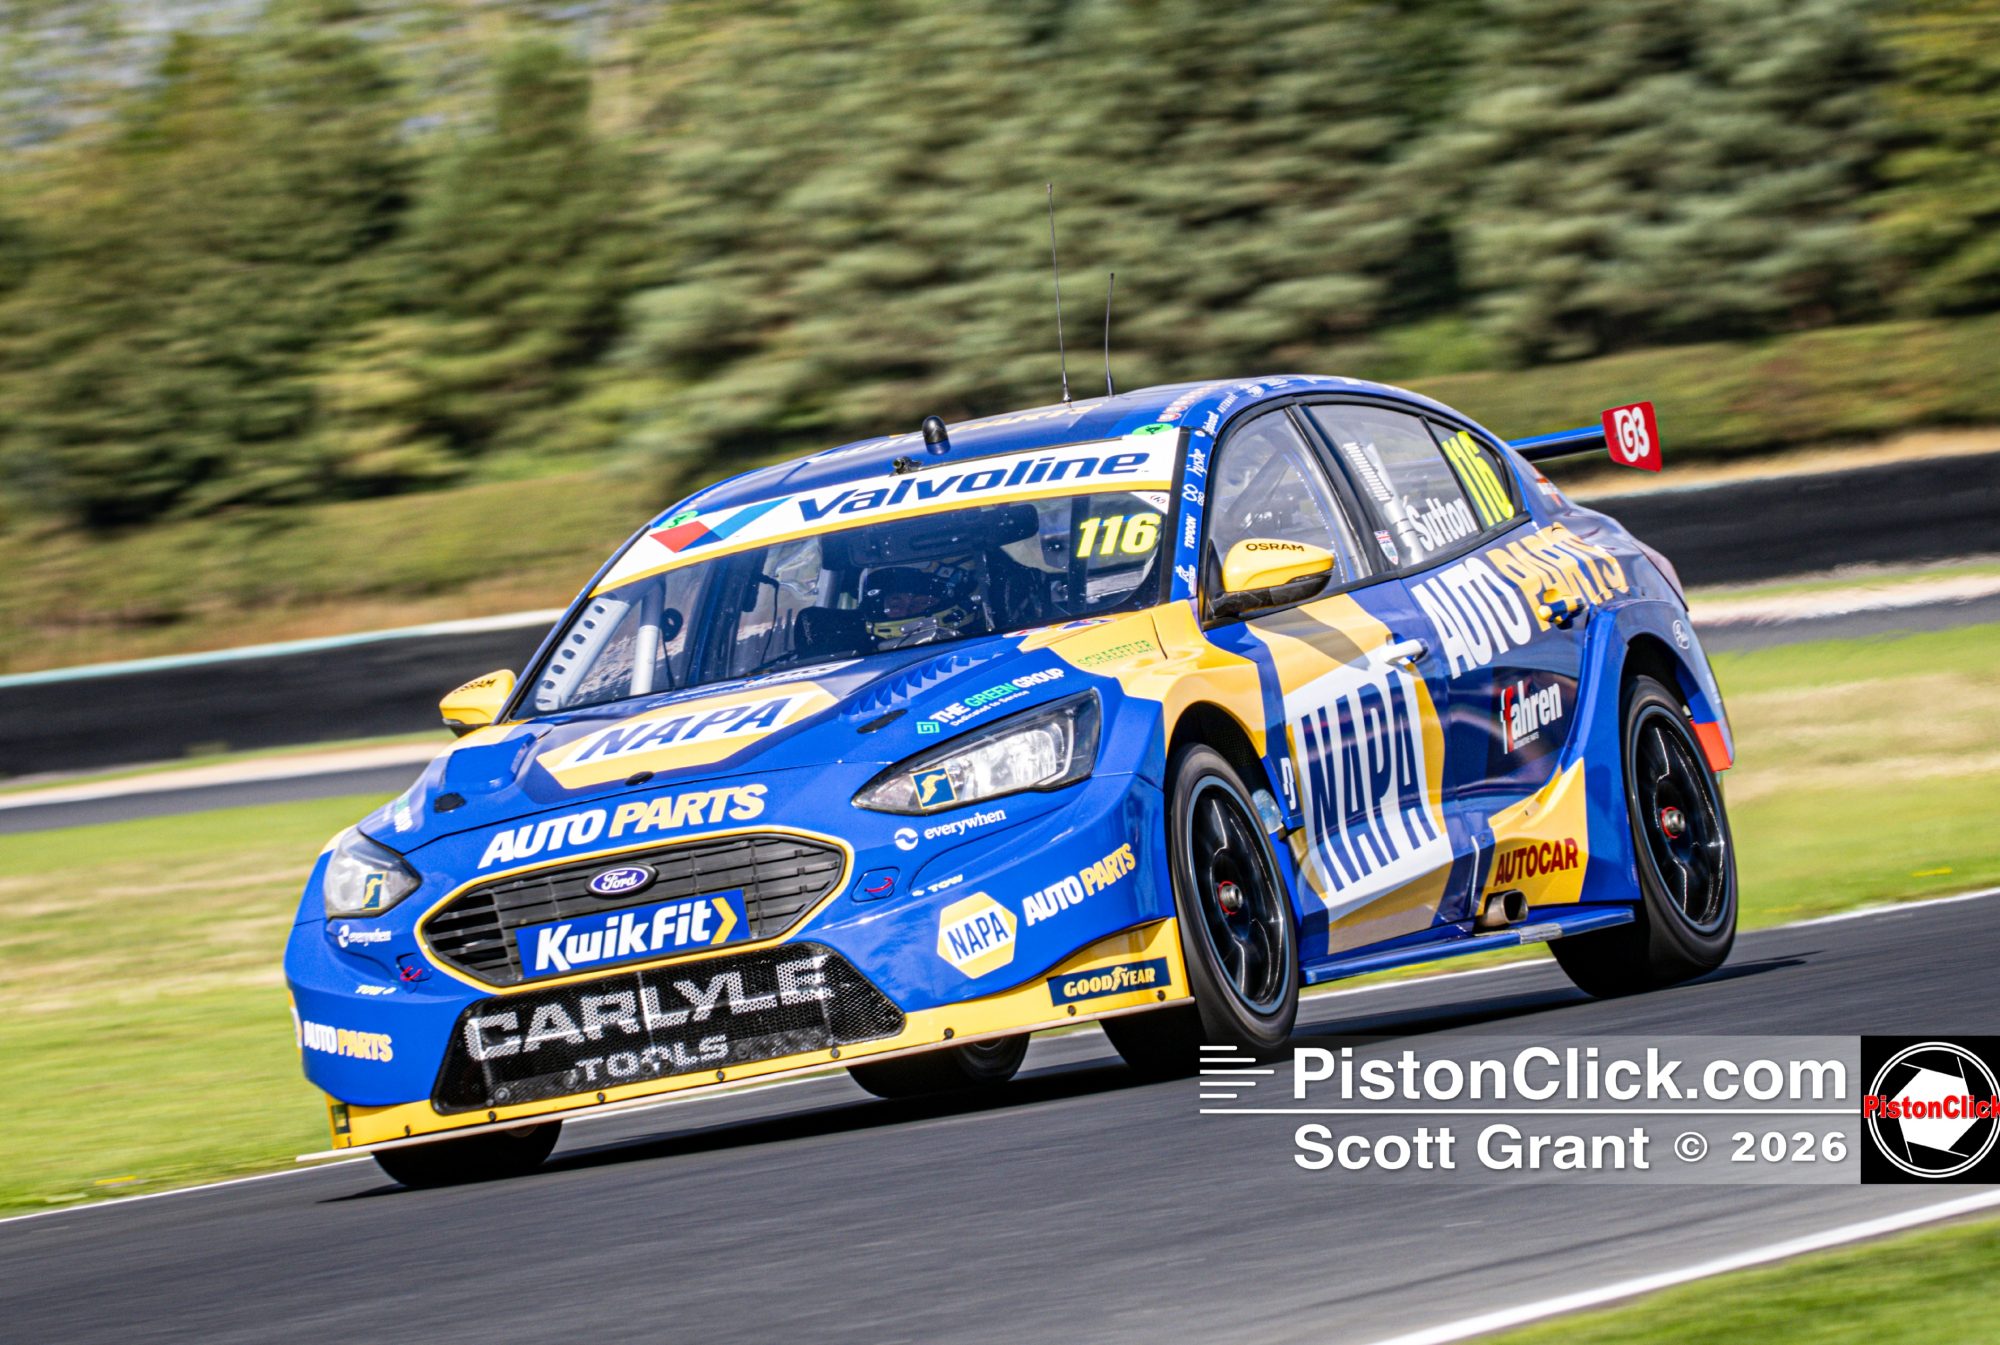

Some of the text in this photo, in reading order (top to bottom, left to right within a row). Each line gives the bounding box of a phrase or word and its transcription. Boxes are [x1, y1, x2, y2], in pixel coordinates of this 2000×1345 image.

[1613, 406, 1650, 463] G3
[798, 452, 1150, 522] Valvoline
[1441, 430, 1514, 527] 116
[1076, 512, 1162, 558] 116
[1246, 542, 1305, 552] OSRAM
[1406, 497, 1477, 551] Sutton
[1410, 522, 1630, 680] AUTO PARTS
[929, 668, 1065, 723] THE GREEN GROUP
[576, 698, 793, 763] NAPA
[1300, 668, 1438, 892] NAPA
[477, 808, 606, 869] AUTO
[608, 784, 767, 838] PARTS
[924, 809, 1006, 841] everywhen
[600, 870, 637, 890] Ford
[928, 875, 963, 892] TOW
[1021, 843, 1136, 928] AUTO PARTS
[1494, 837, 1579, 886] AUTOCAR
[947, 911, 1009, 960] NAPA
[464, 955, 834, 1062] CARLYLE
[303, 1021, 337, 1054] AUTO
[336, 1029, 393, 1062] PARTS
[575, 1034, 729, 1082] TOOLS
